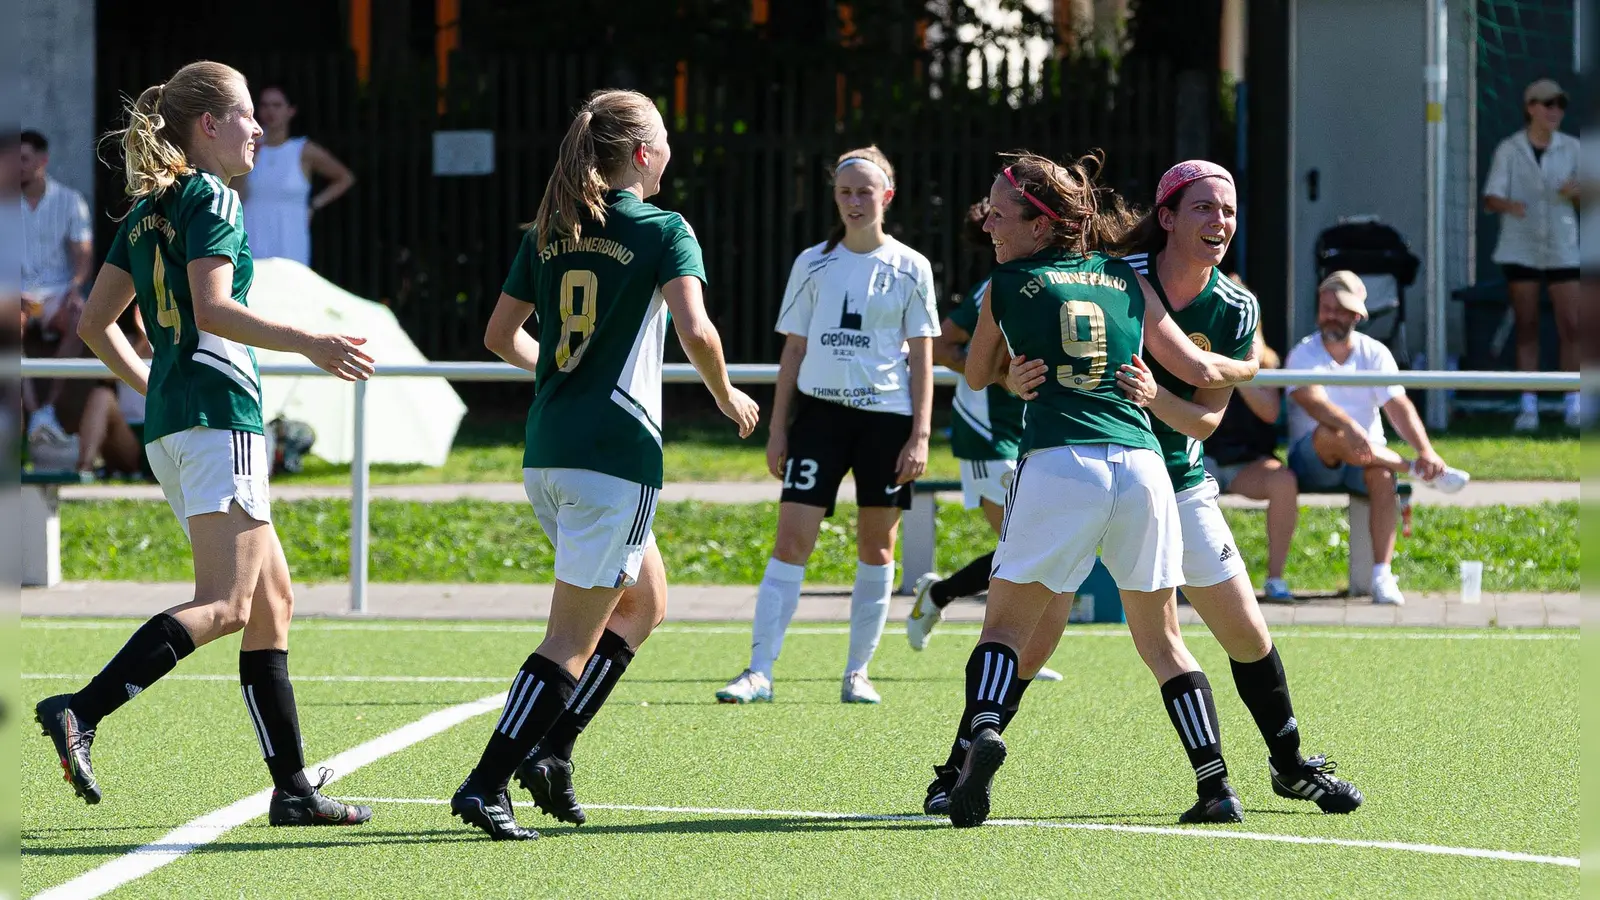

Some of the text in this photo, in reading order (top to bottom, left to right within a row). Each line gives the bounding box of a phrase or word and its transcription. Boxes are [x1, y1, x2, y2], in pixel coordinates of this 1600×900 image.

[539, 236, 635, 266] TSV TURNERBUND
[153, 243, 181, 345] 4
[1019, 271, 1128, 299] TSV TURNERBUND
[555, 270, 598, 373] 8
[1056, 300, 1108, 391] 9
[812, 386, 841, 398] THINK
[783, 457, 819, 491] 13
